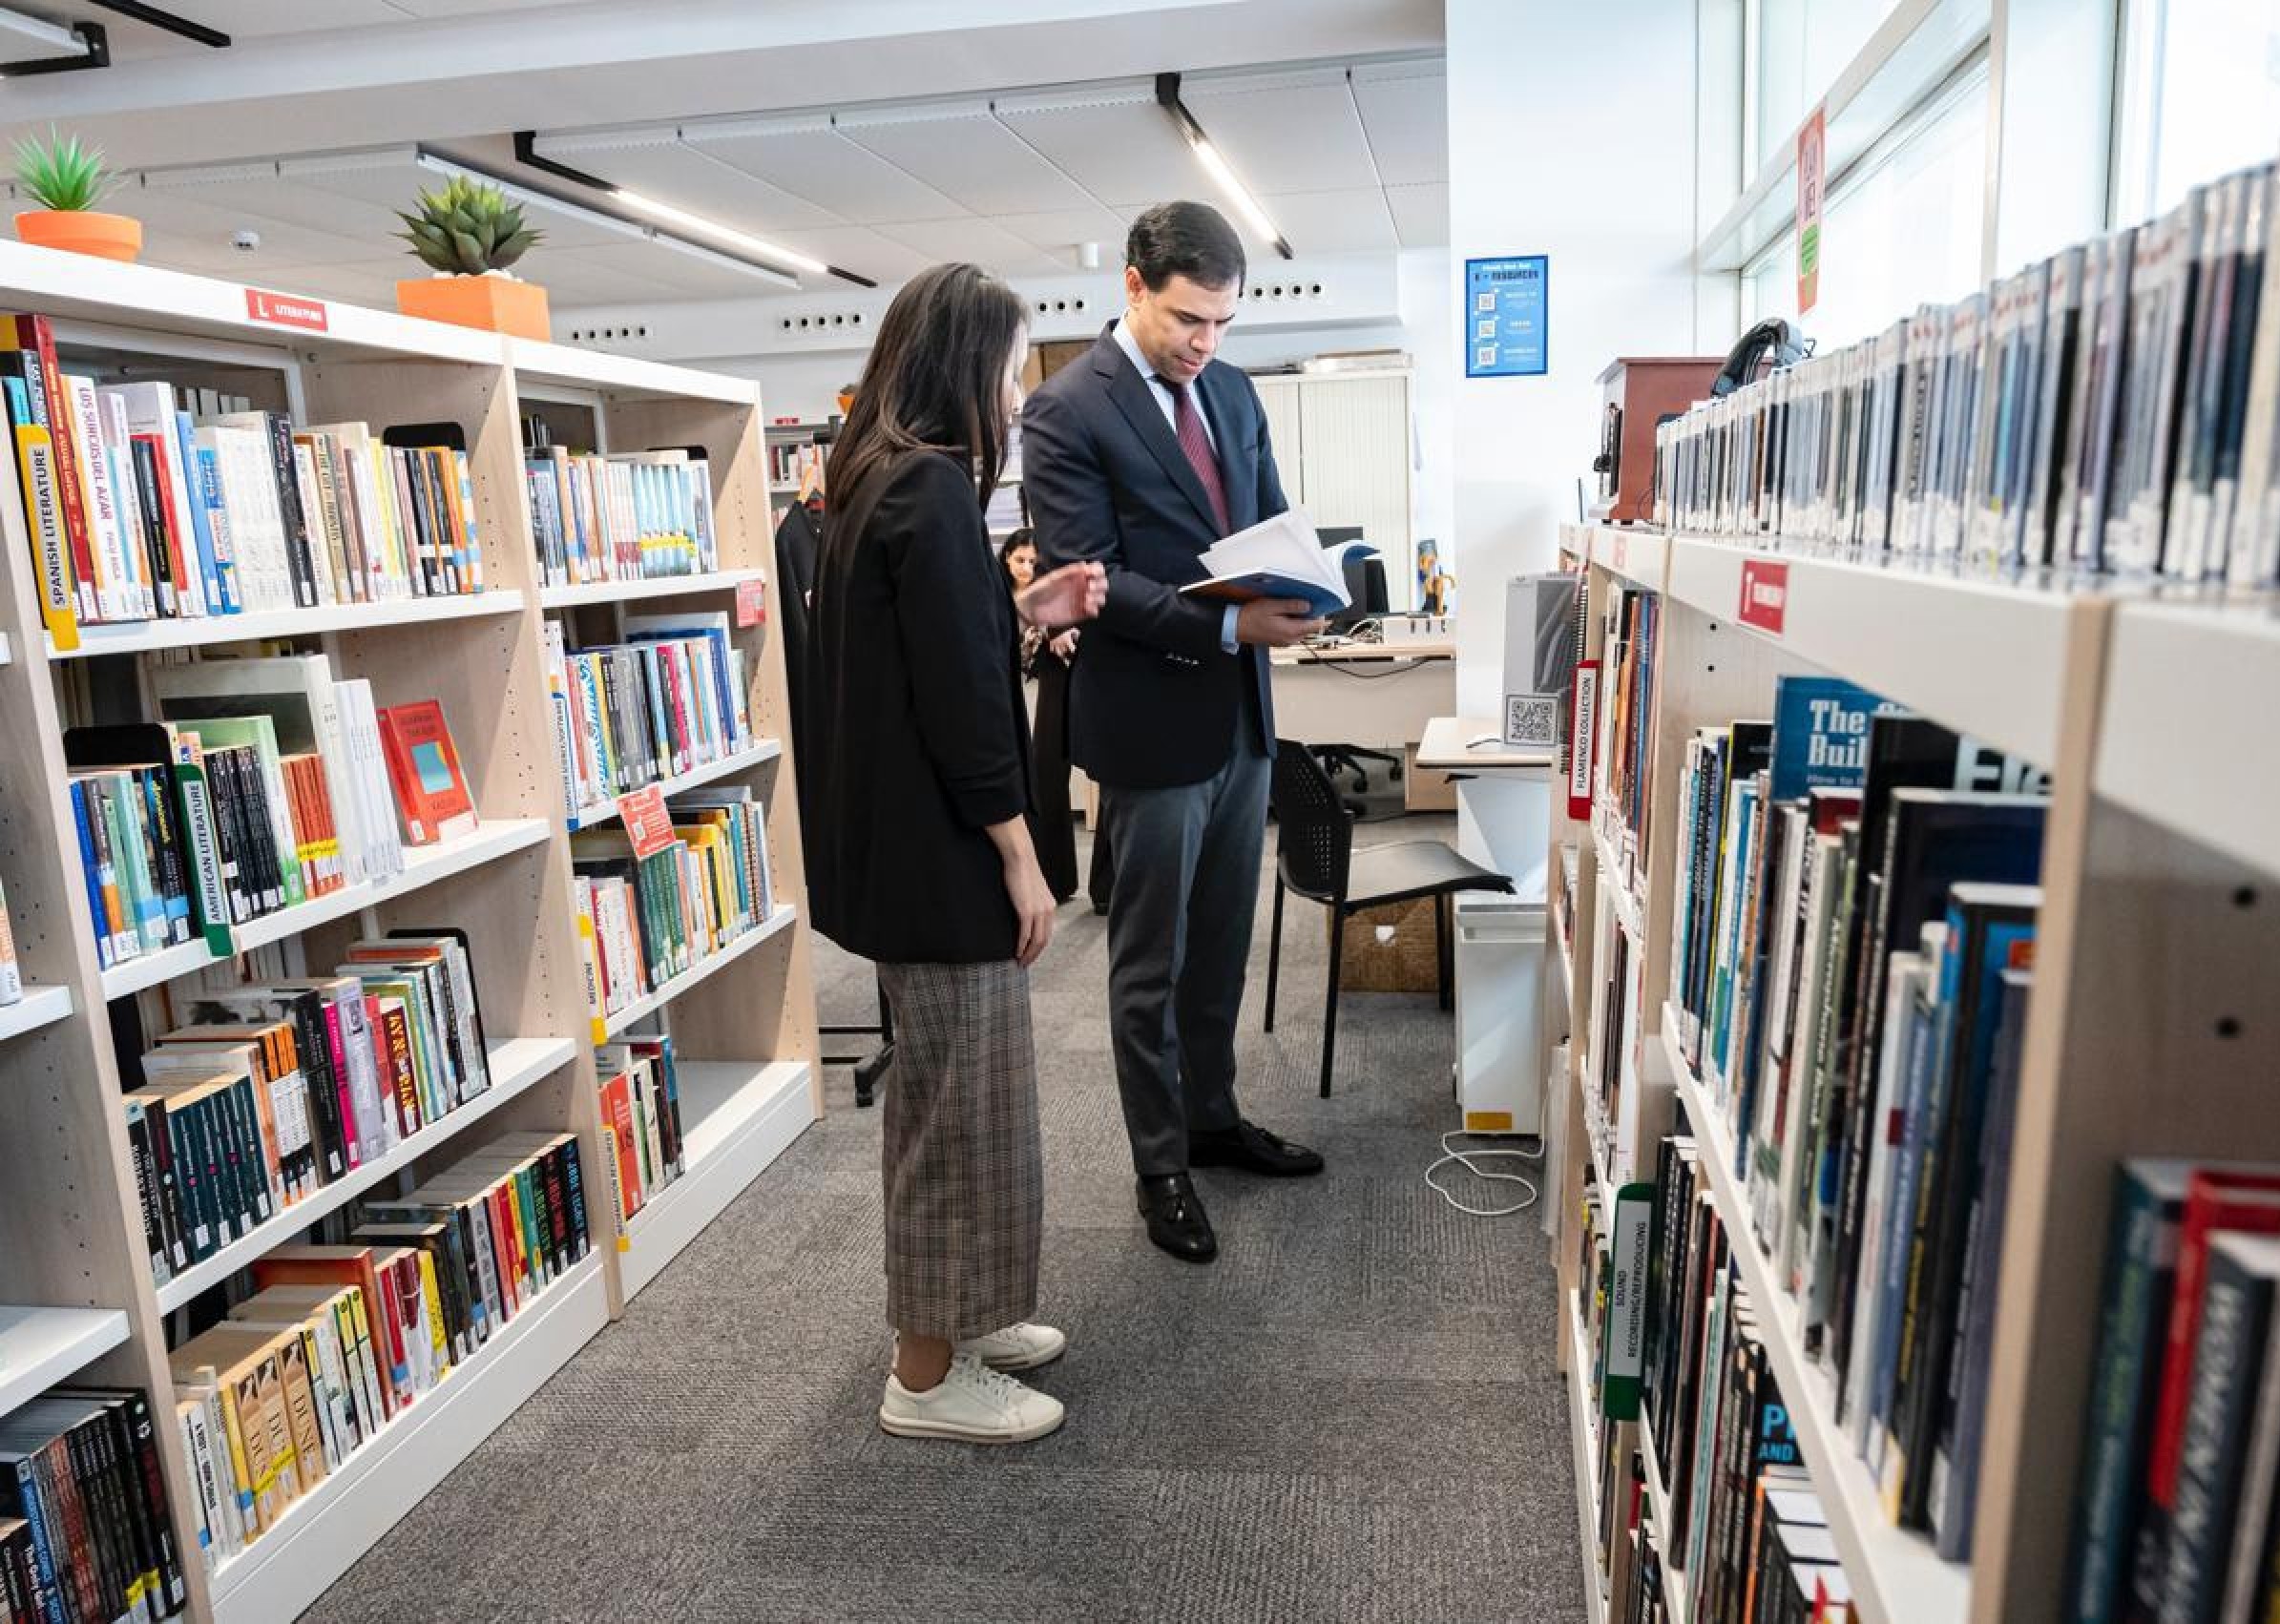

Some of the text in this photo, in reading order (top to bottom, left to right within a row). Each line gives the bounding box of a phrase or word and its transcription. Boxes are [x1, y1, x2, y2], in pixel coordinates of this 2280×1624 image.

[34, 449, 65, 606] SPANISH LITERATURE
[1577, 677, 1591, 789] FLAMENCO COLLECTION
[1809, 700, 1866, 734] The
[189, 783, 220, 922] AMERICAN LITERATURE
[1616, 1269, 1627, 1307] SOUND
[1628, 1220, 1646, 1358] RECORDING/REPRODUCING
[292, 1393, 316, 1453] DUNE
[1757, 1442, 1794, 1462] AND
